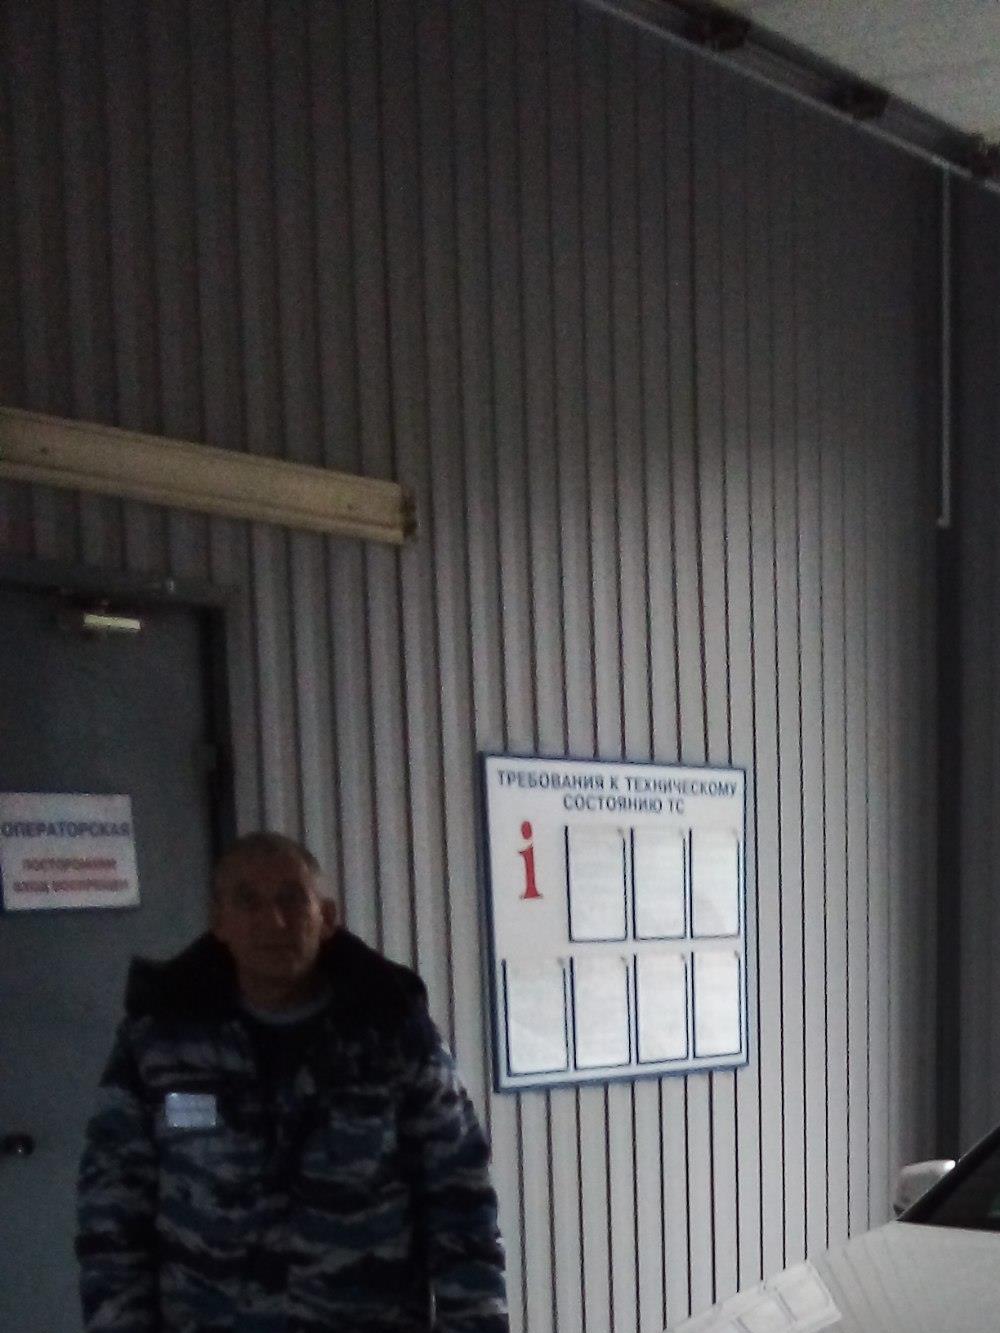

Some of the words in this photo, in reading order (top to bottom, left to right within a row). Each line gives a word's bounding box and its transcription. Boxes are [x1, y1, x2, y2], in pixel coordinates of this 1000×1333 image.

[497, 770, 604, 791] ТРЕБОВАНИЯ
[610, 776, 619, 790] К
[624, 776, 738, 797] ТЕХНИЧЕСКОМУ
[563, 794, 662, 812] СОСТОЯНИЮ
[667, 799, 685, 815] ТС
